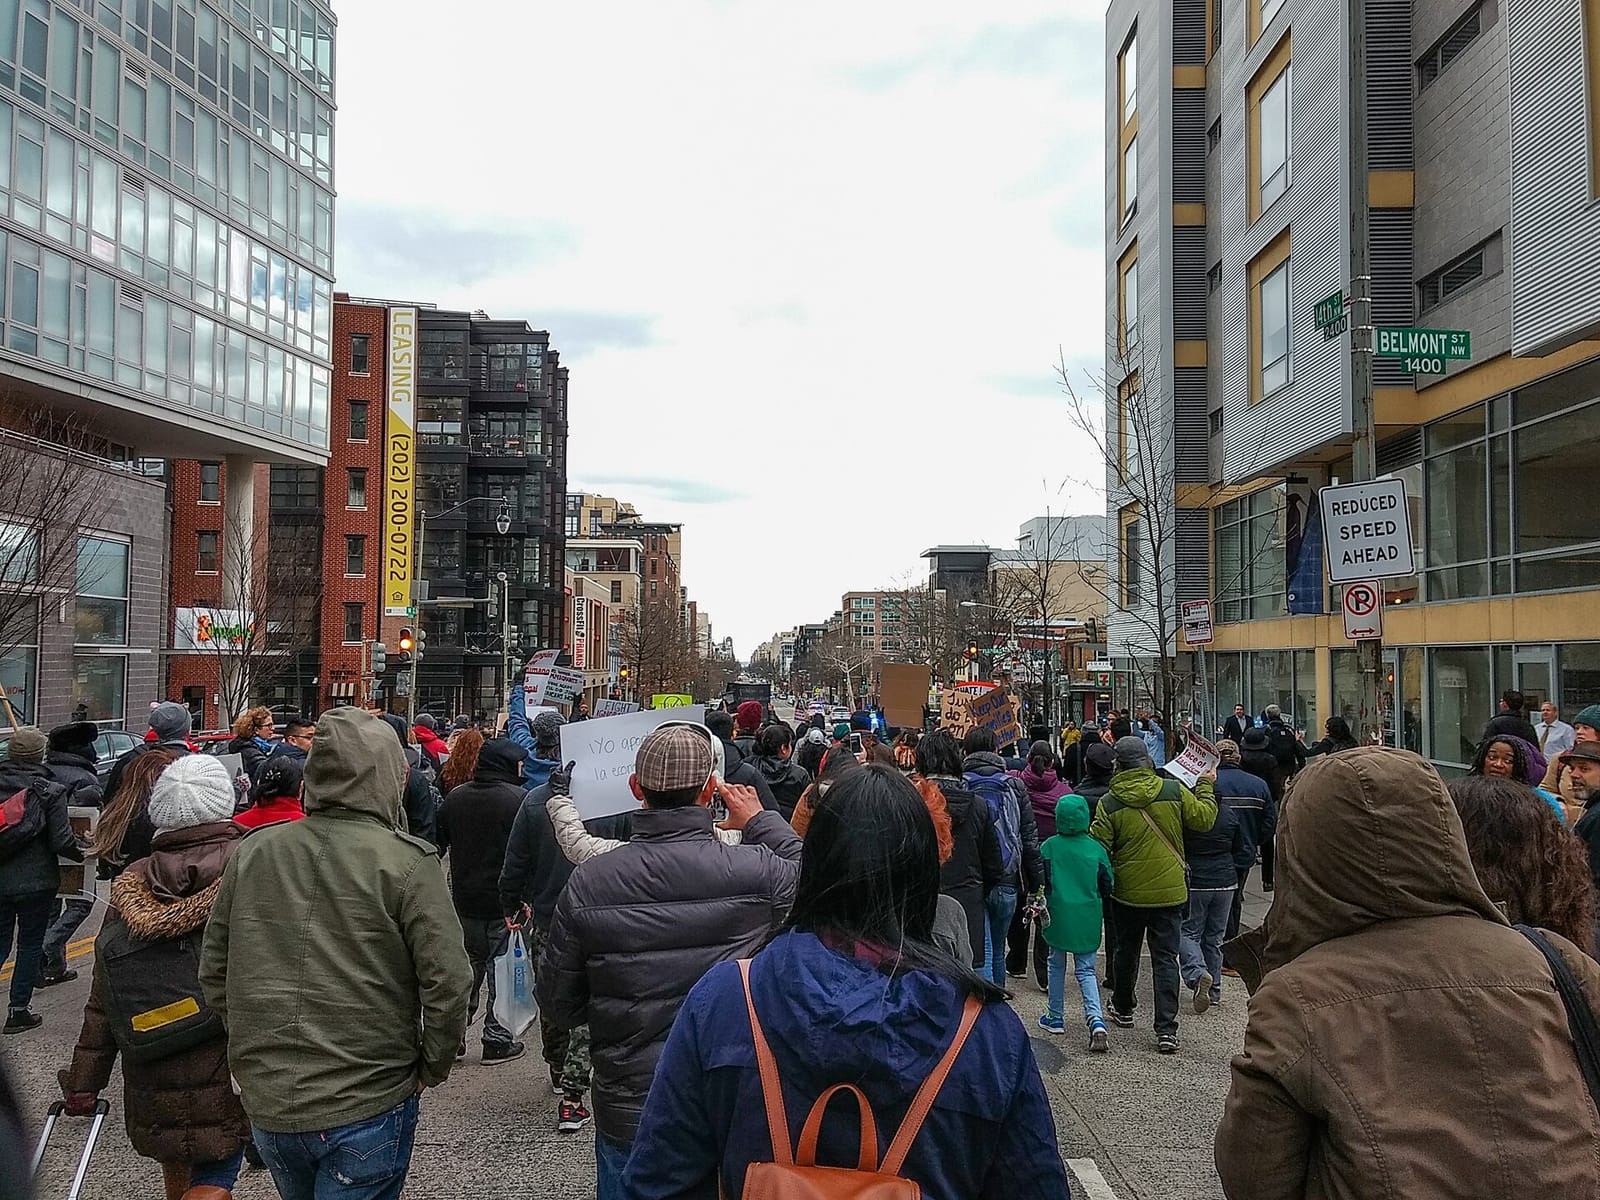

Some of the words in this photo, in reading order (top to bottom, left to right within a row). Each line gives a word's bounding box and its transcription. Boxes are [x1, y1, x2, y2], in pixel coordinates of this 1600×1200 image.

[1315, 301, 1332, 326] 14th
[1334, 294, 1340, 305] ST
[1325, 317, 1346, 340] 2400
[1380, 331, 1447, 354] BELMONT
[1451, 334, 1465, 343] ST
[1451, 345, 1465, 355] NW
[391, 312, 413, 402] LEASING
[1404, 358, 1441, 373] 1400
[390, 433, 411, 482] (202)
[1331, 494, 1397, 516] REDUCED
[390, 489, 408, 581] 200-0722
[1340, 520, 1397, 540] SPEED
[1342, 545, 1398, 565] AHEAD
[605, 701, 632, 712] FIGHT
[1195, 743, 1207, 758] the
[594, 768, 607, 780] la
